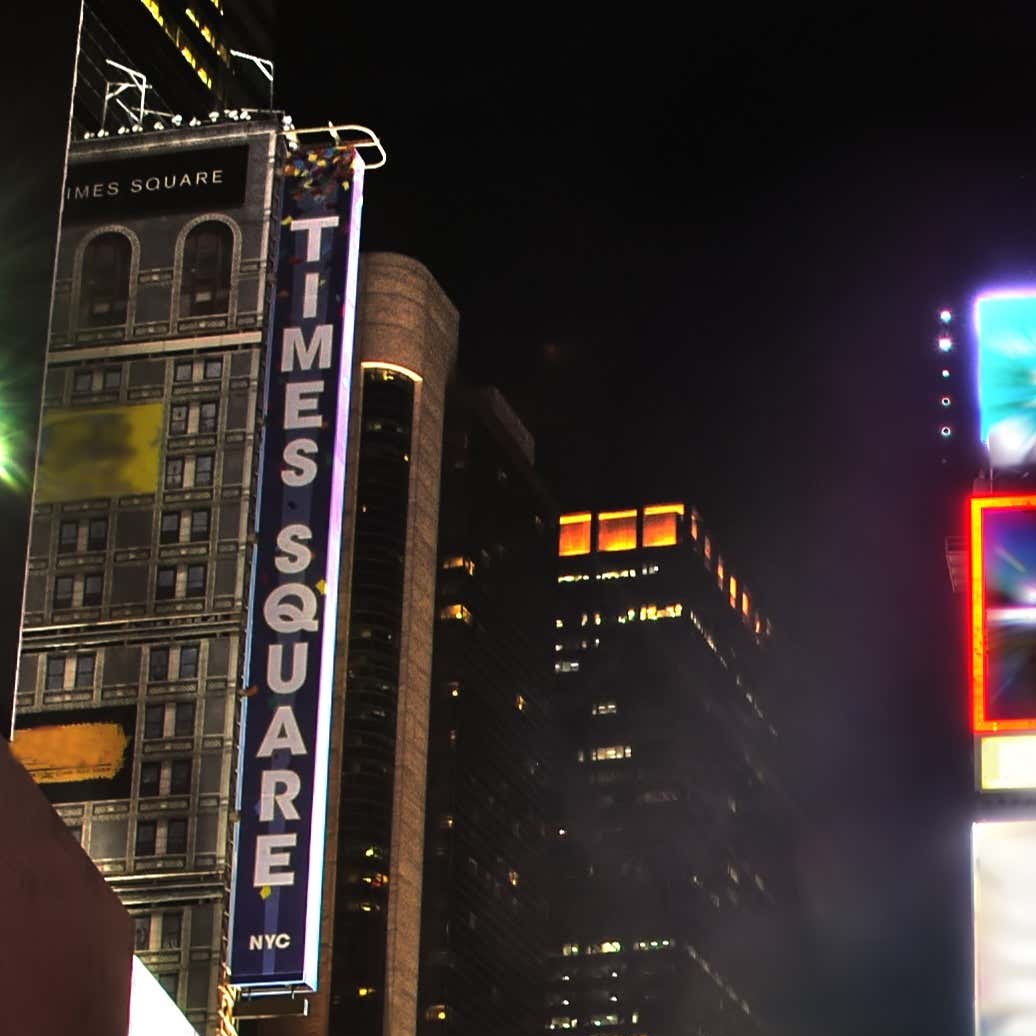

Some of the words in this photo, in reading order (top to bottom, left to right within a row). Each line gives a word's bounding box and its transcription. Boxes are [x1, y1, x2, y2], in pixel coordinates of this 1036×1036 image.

[131, 169, 223, 193] SQUARE
[280, 216, 339, 488] TIMES
[253, 523, 319, 887] SQUARE
[249, 933, 291, 950] NYC
